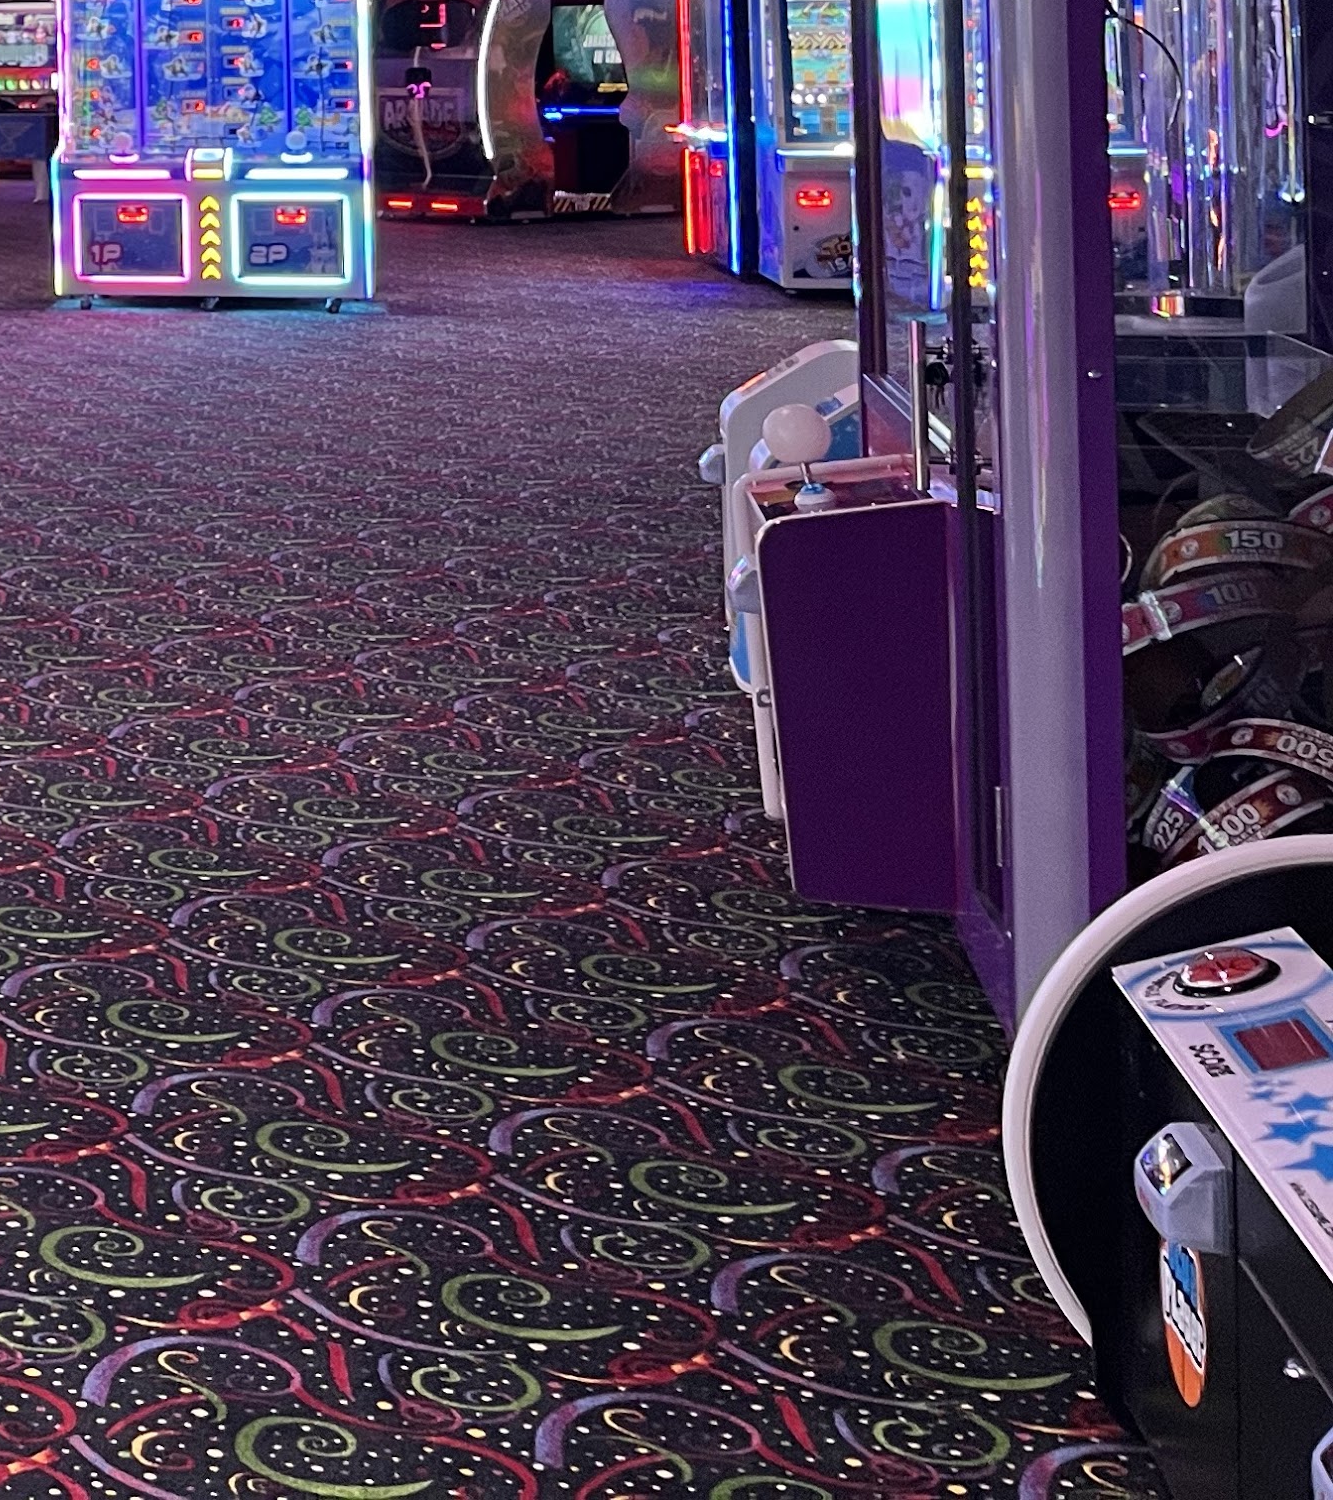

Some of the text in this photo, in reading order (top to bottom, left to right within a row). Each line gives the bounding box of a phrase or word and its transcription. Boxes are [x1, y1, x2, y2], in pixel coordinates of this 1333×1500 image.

[90, 243, 123, 264] 1P
[249, 243, 288, 264] 2P
[1224, 529, 1284, 550] 150
[1153, 806, 1185, 850] 225
